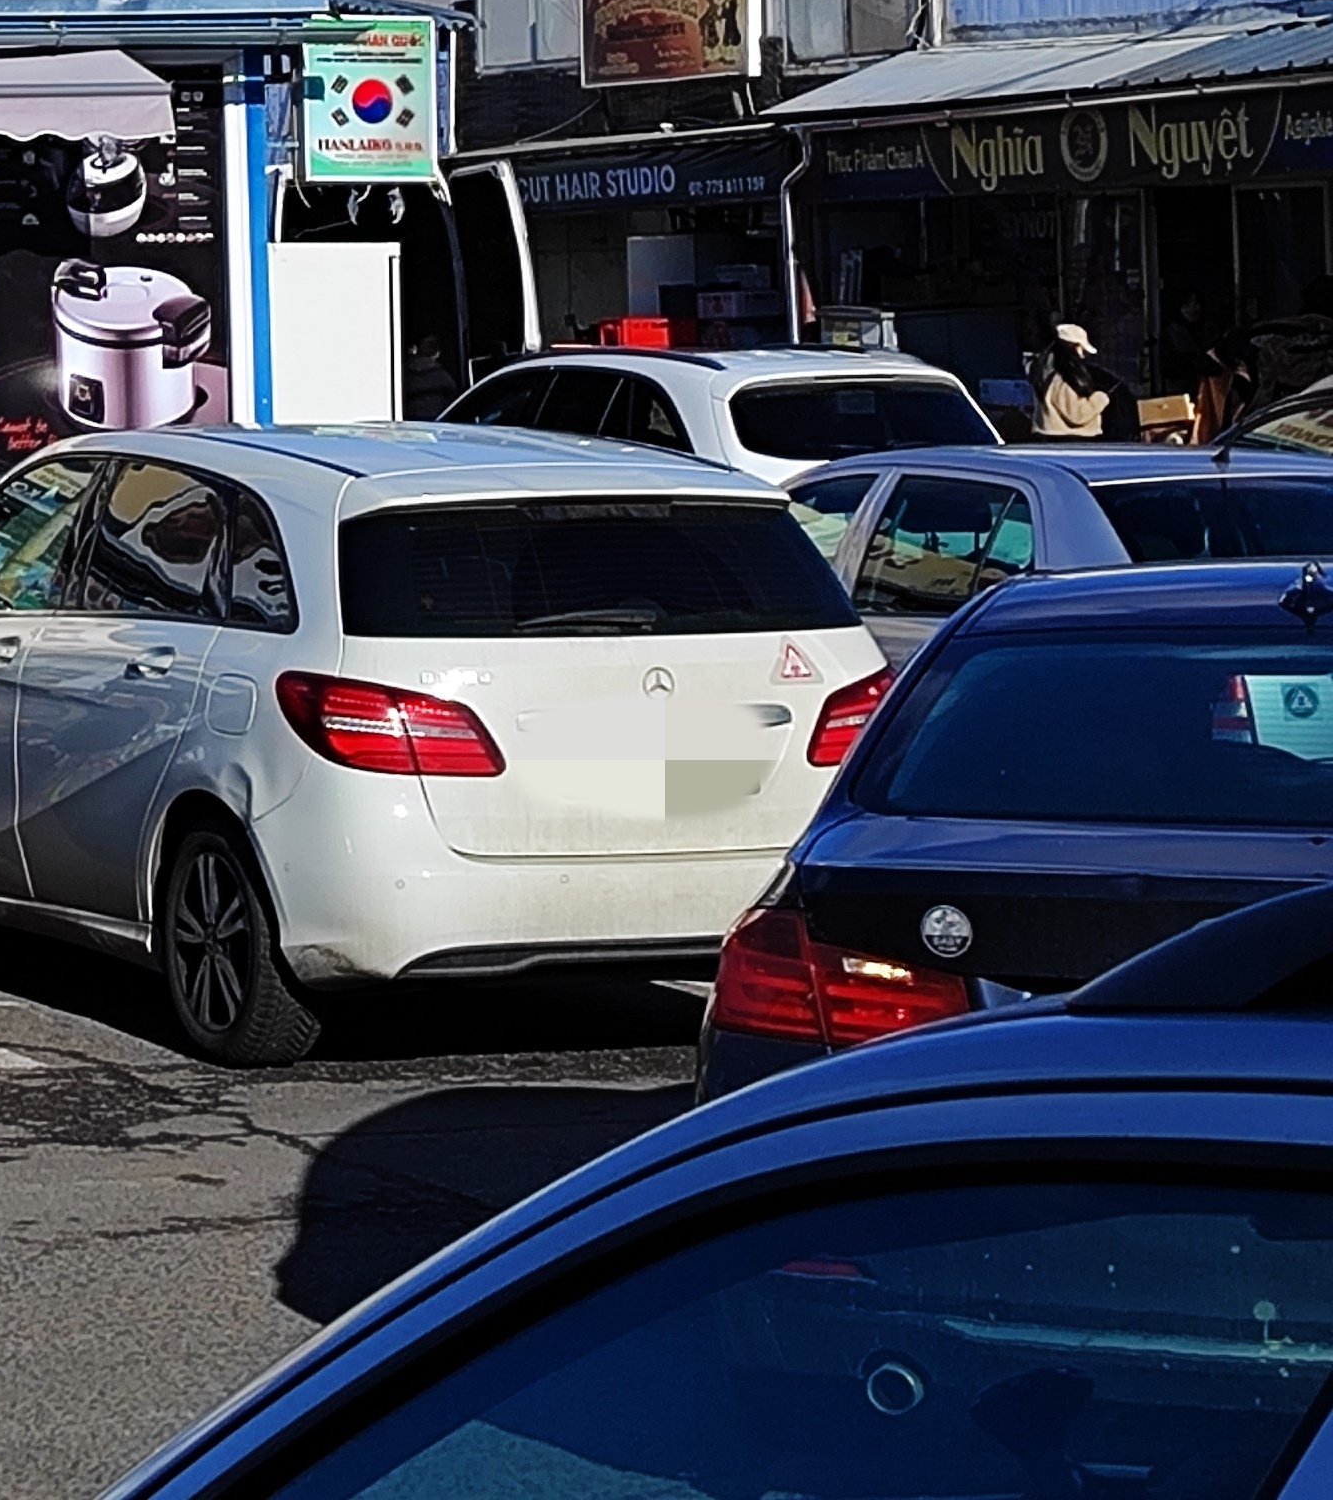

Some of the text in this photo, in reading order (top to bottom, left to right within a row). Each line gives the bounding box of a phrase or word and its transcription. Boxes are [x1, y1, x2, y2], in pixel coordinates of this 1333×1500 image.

[951, 102, 1255, 192] Nghĩa Nguyệt
[556, 171, 602, 201] HAIR
[606, 164, 676, 198] STUDIO
